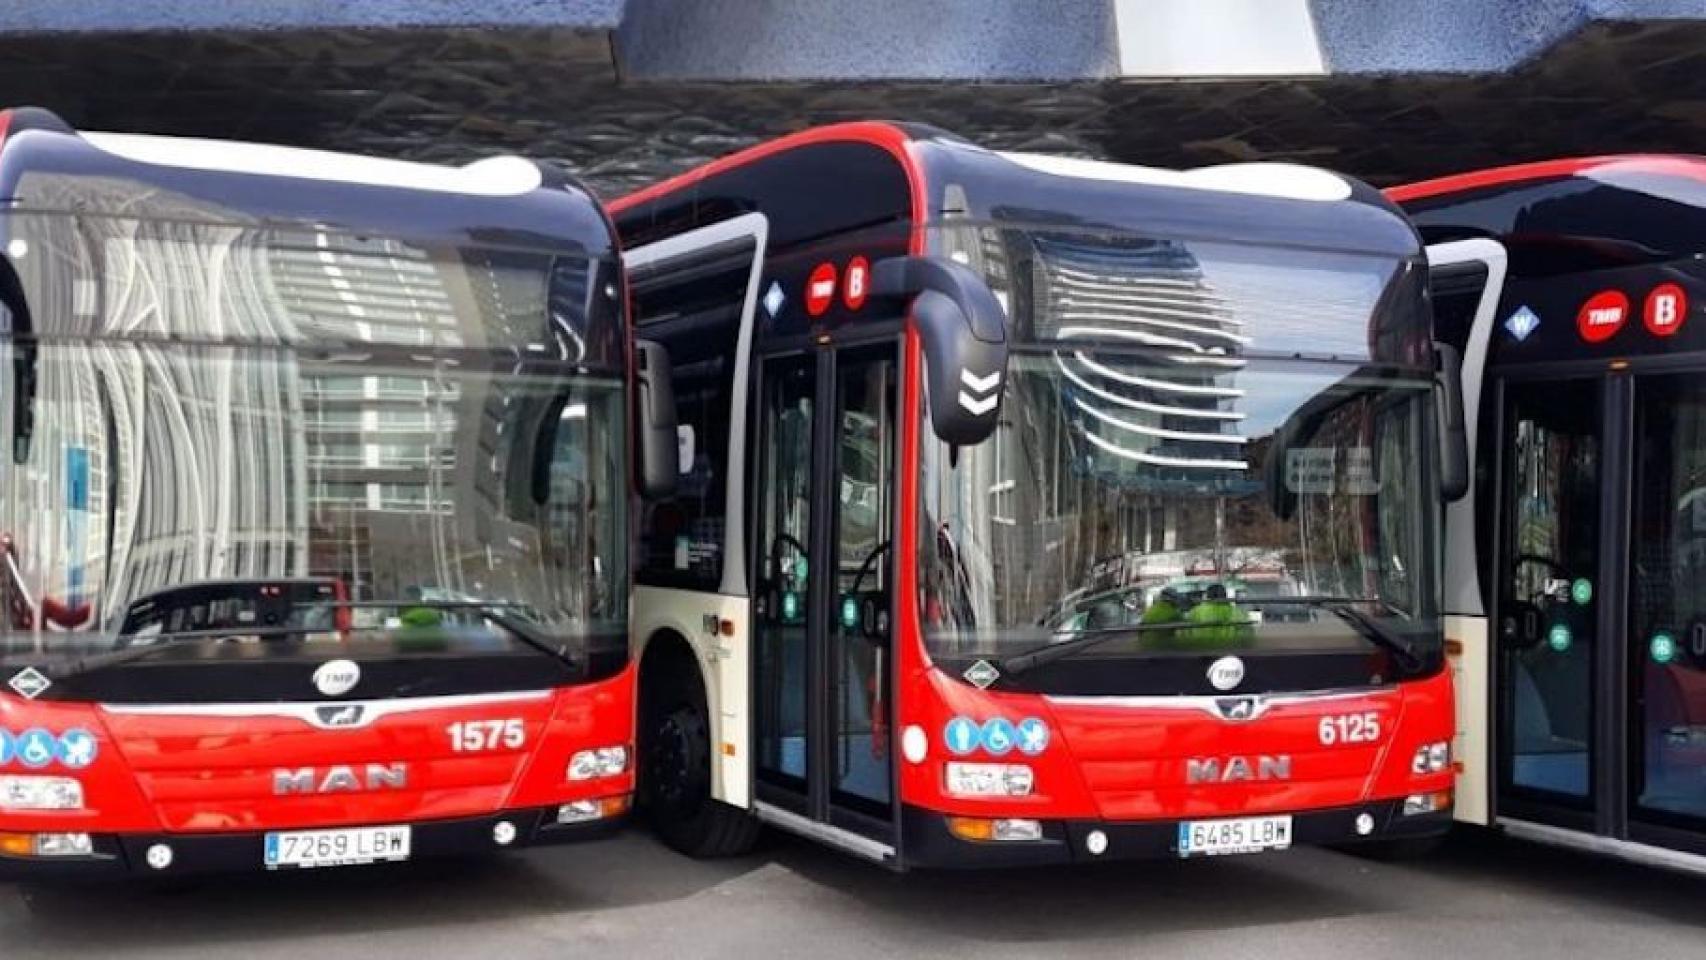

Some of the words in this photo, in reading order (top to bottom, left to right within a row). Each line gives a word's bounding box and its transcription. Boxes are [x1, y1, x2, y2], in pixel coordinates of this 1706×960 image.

[851, 268, 863, 297] B
[1589, 308, 1621, 324] TMB
[1654, 295, 1677, 325] B
[447, 719, 524, 751] 1575
[1320, 713, 1378, 744] 6125
[274, 763, 405, 794] MAN
[1187, 756, 1290, 783] MAN
[284, 834, 348, 860] 7269
[357, 831, 403, 855] LBW
[1194, 822, 1243, 846] 6485
[1251, 820, 1286, 842] LBW
